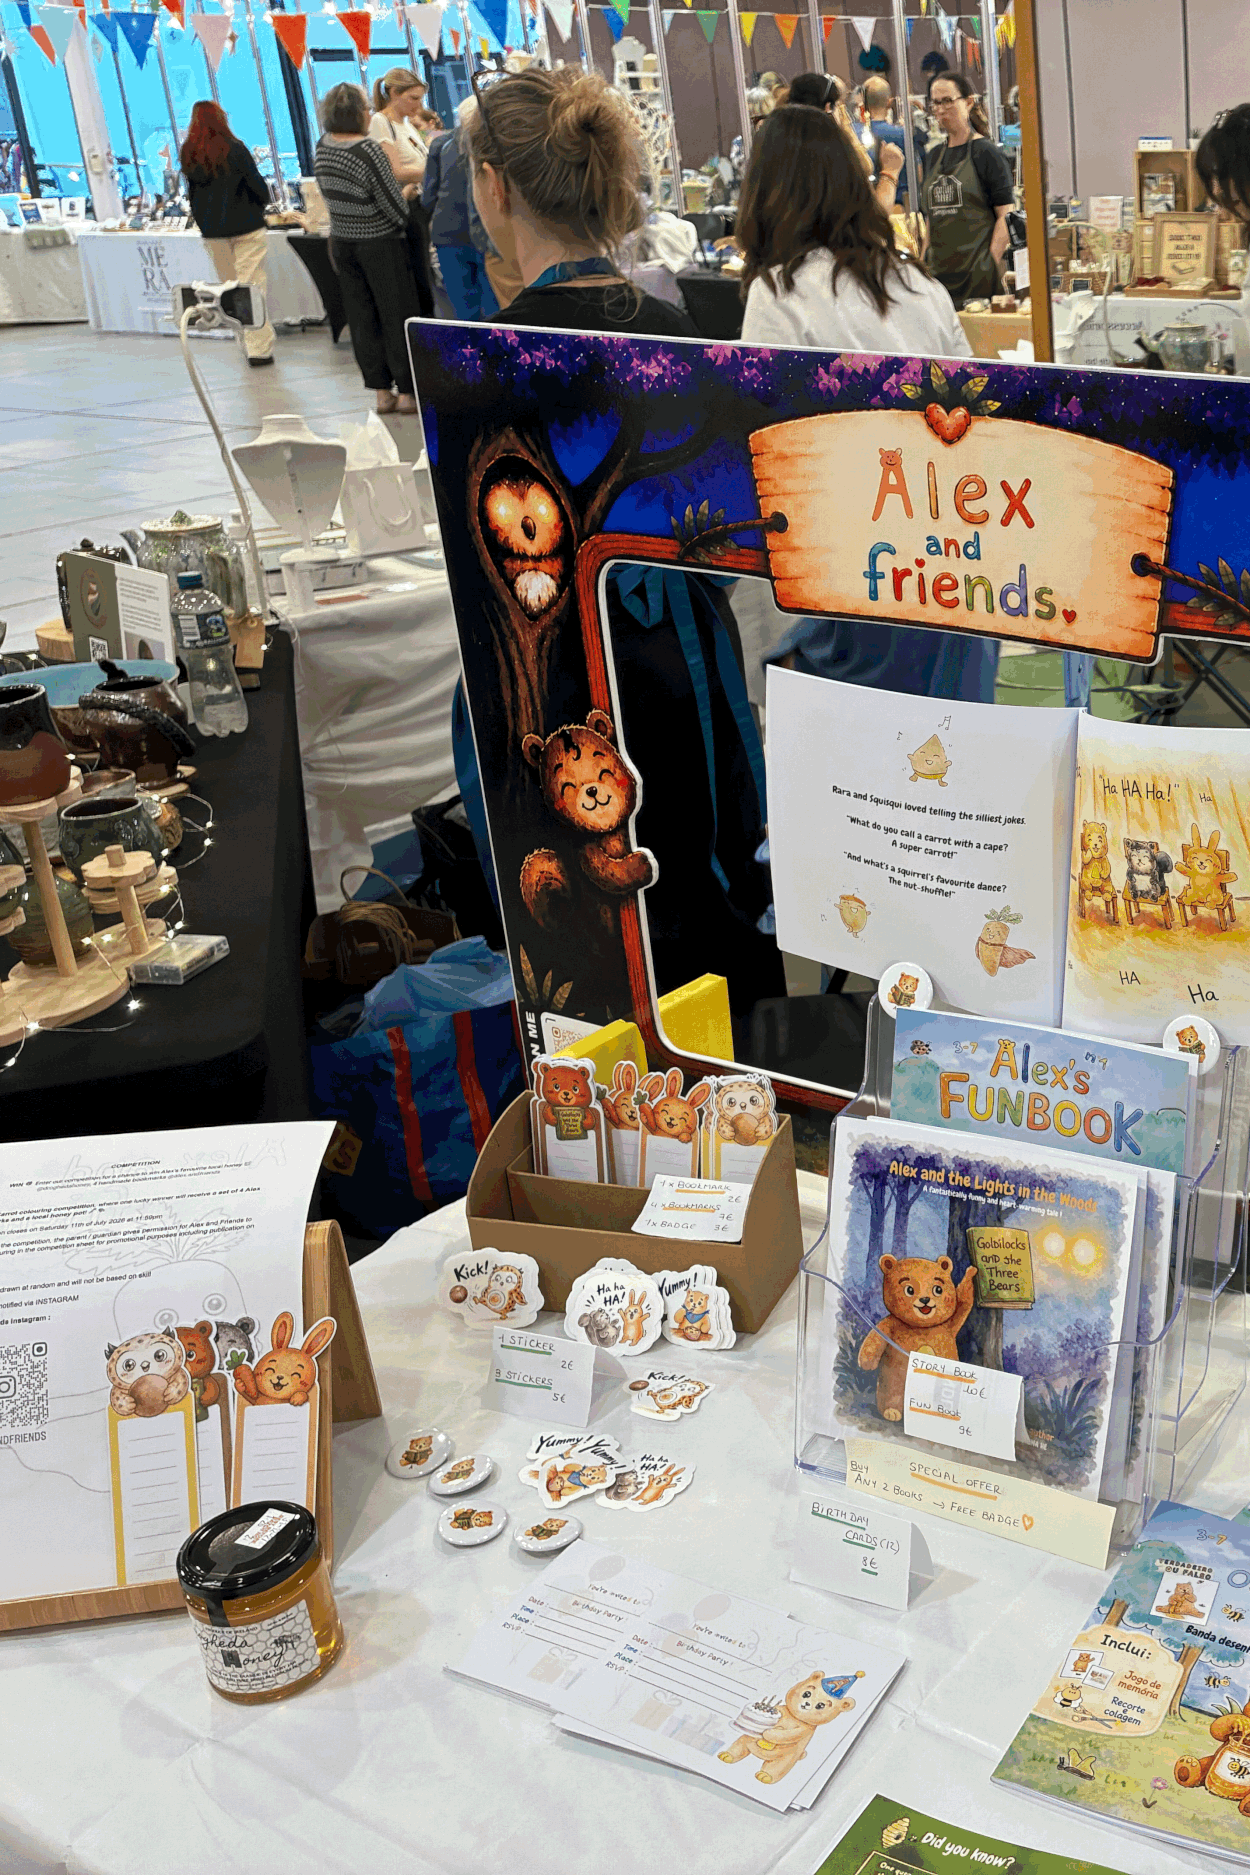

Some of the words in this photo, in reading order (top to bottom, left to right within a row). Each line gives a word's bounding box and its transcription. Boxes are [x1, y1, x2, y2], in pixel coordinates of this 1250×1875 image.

[872, 448, 1035, 529] Alex
[925, 531, 981, 561] and
[832, 785, 850, 797] Rara
[853, 790, 867, 801] and
[869, 794, 902, 810] Squisqui
[904, 801, 927, 813] loved
[929, 806, 956, 821] telling
[958, 810, 973, 821] the
[975, 812, 1002, 823] silliest
[1002, 814, 1026, 826] jokes.
[846, 814, 870, 828] "What
[872, 821, 882, 830] do
[883, 824, 898, 835] you
[900, 828, 915, 839] call
[917, 832, 922, 840] a
[924, 833, 952, 845] carrot
[954, 837, 974, 848] with
[975, 842, 981, 850] a
[983, 843, 1009, 854] cape?
[891, 839, 897, 847] A
[899, 842, 922, 853] super
[843, 851, 862, 862] "And
[863, 855, 889, 870] what's
[897, 866, 934, 881] squirrel's
[936, 874, 975, 889] favourite
[977, 881, 1007, 893] dance?
[888, 876, 901, 886] The
[525, 1011, 538, 1038] ME
[990, 1039, 1091, 1095] Alex's
[939, 1072, 1143, 1156] FUNBOOK
[889, 1161, 918, 1178] Alex
[921, 1168, 945, 1183] and
[948, 1170, 971, 1187] the
[974, 1174, 1015, 1197] Lights
[1018, 1184, 1031, 1199] in
[1034, 1186, 1056, 1203] the
[1059, 1192, 1098, 1213] Woods
[1003, 1255, 1022, 1266] the
[30, 1279, 56, 1290] random
[71, 1278, 82, 1286] will
[106, 1273, 127, 1282] based
[128, 1272, 137, 1280] on
[138, 1270, 152, 1279] skill
[453, 1260, 490, 1282] Kick!
[986, 1266, 1019, 1279] Three
[597, 1283, 612, 1296] Ha
[613, 1282, 626, 1293] ha
[989, 1279, 1020, 1292] Bears
[24, 1299, 34, 1307] via
[35, 1294, 80, 1306] INSTAGRAM
[603, 1292, 626, 1307] HA!
[560, 1360, 574, 1370] 2€
[552, 1392, 566, 1404] 5€
[538, 1434, 595, 1453] Yummy!
[578, 1439, 627, 1471] Yummy!
[965, 1476, 1002, 1495] OFFER
[854, 1474, 878, 1490] ANY
[882, 1482, 889, 1492] 2
[950, 1502, 977, 1517] FREE
[982, 1509, 1020, 1528] BADGE
[845, 1530, 878, 1547] CARDS
[880, 1537, 900, 1554] (12)
[862, 1556, 878, 1570] 8€
[1185, 1624, 1216, 1643] Banda
[921, 1831, 948, 1849] Did
[942, 1839, 970, 1858] you
[970, 1848, 1016, 1869] know?
